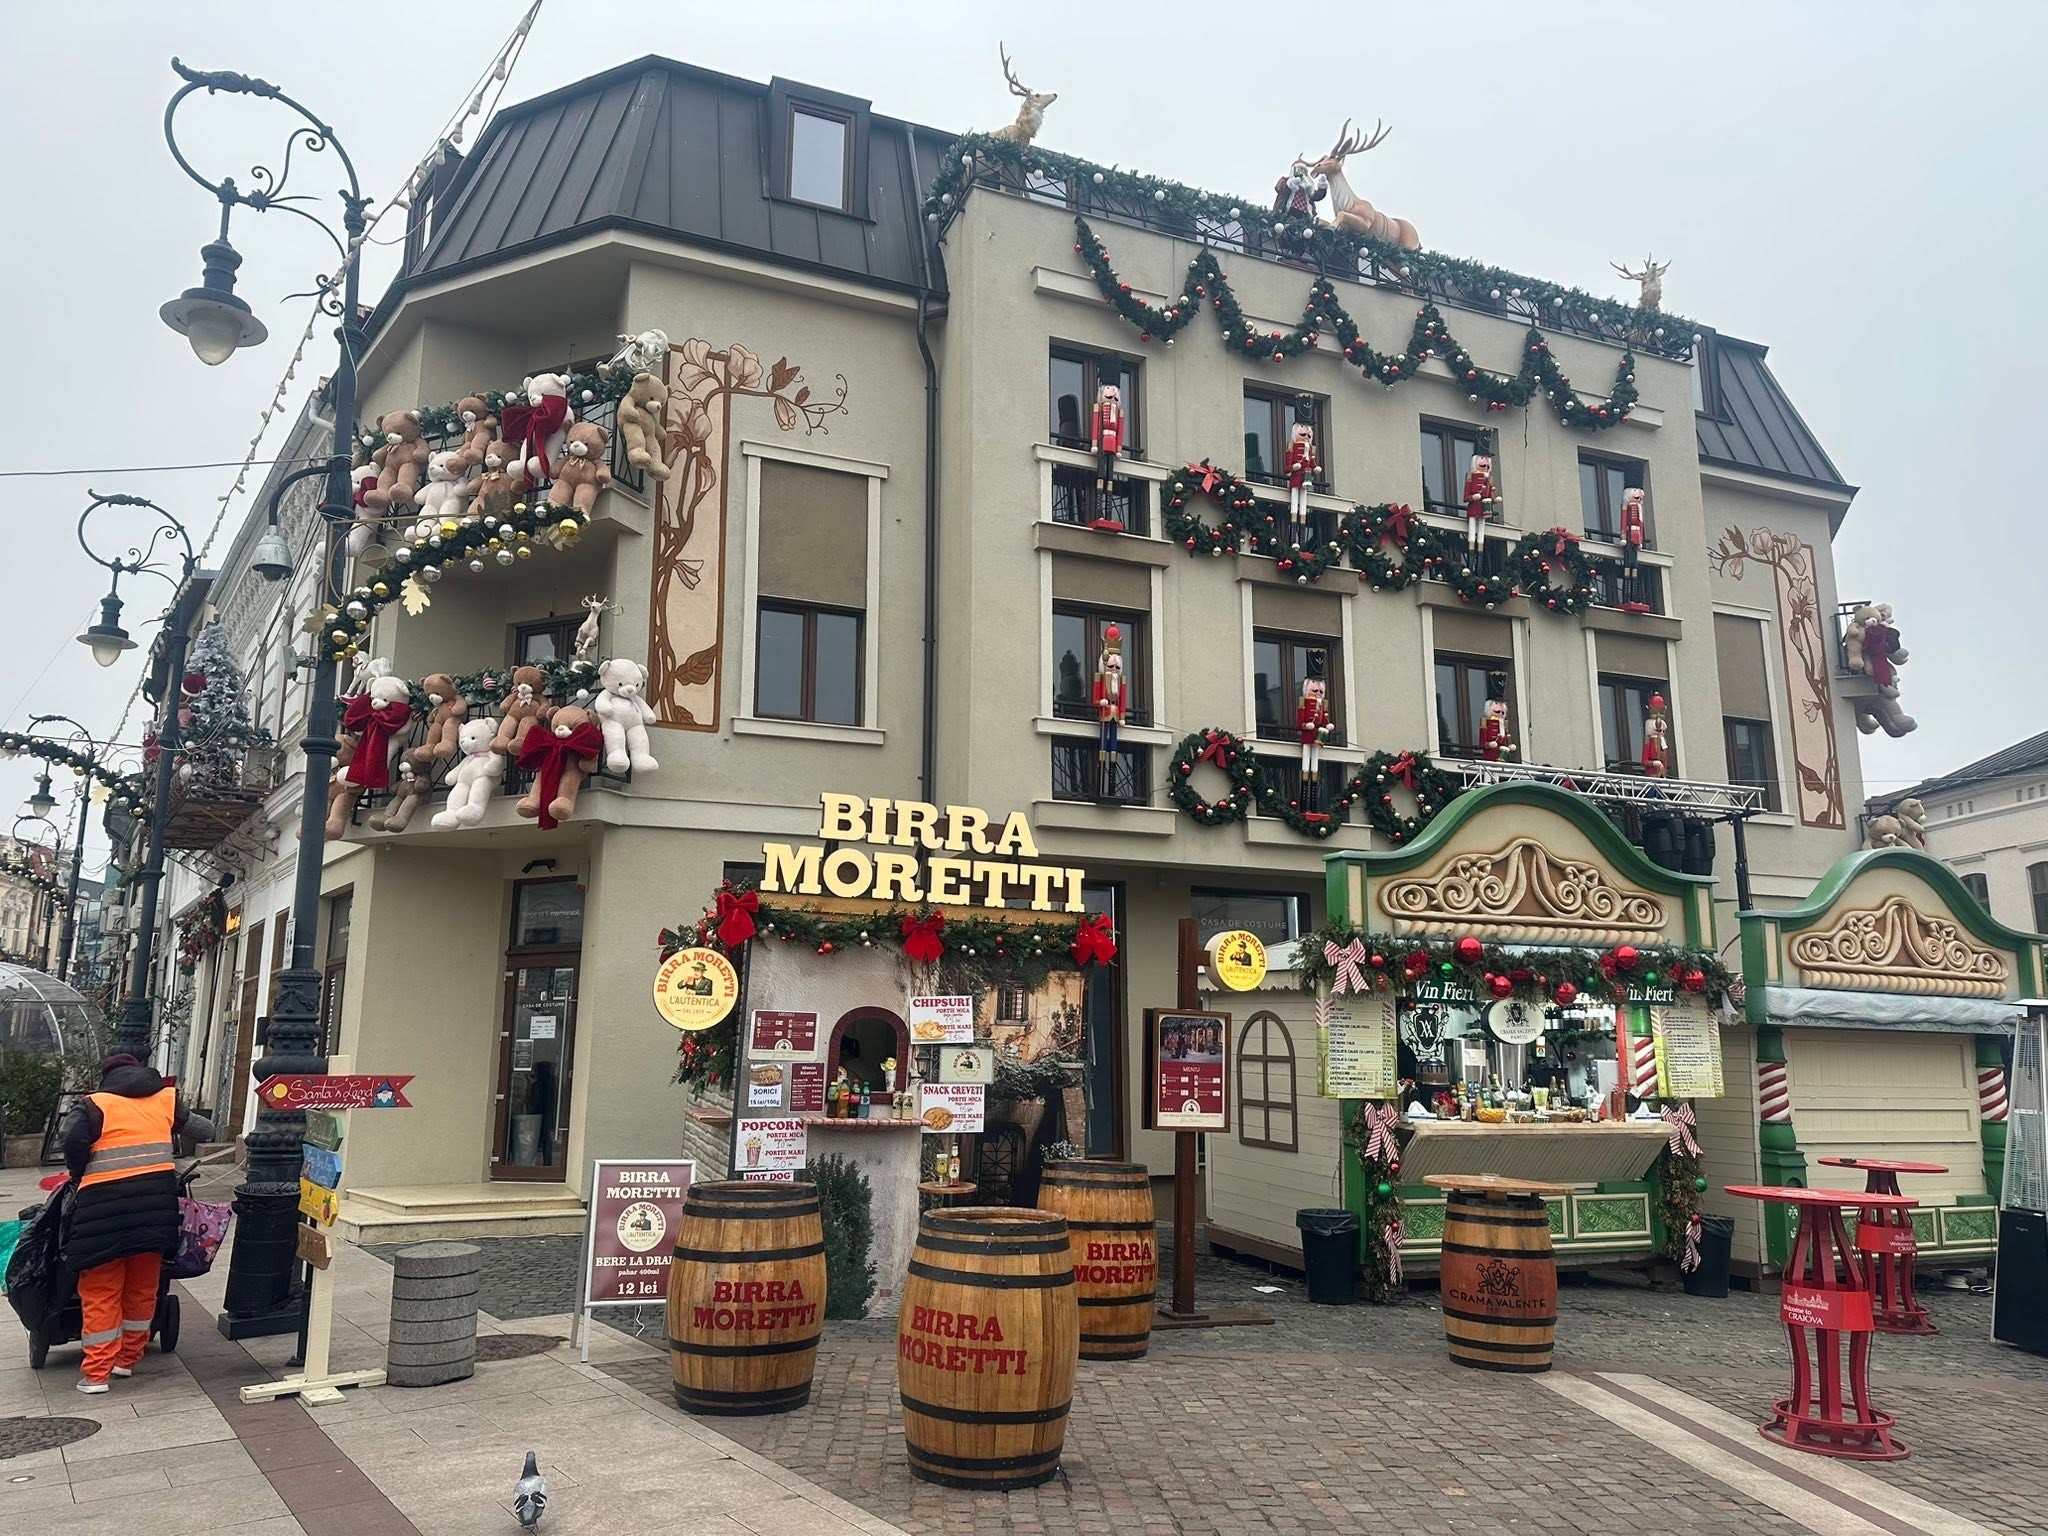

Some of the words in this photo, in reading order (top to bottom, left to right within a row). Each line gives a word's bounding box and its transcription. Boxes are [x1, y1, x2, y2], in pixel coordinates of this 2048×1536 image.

[819, 792, 1039, 857] BIRRA
[760, 842, 1085, 912] MORETTI
[1244, 921, 1288, 930] COSTUME
[1218, 935, 1237, 964] BIRRA
[1238, 933, 1266, 968] MORETTI
[657, 954, 691, 993] BIRRA
[693, 952, 734, 998] MORETTI
[1416, 980, 1438, 999] Vin
[1627, 983, 1643, 1000] in
[1644, 985, 1674, 1001] Fiert
[670, 996, 720, 1007] L'AUTENTICA
[913, 998, 970, 1007] CHIPSURI
[923, 1086, 949, 1094] SNACK
[951, 1086, 983, 1094] CREVETI
[742, 1121, 804, 1131] POPCORN
[619, 1172, 670, 1183] BIRRA
[606, 1187, 681, 1199] MORETTI
[619, 1206, 638, 1231] BIRRA
[638, 1204, 664, 1231] MORETTI
[1087, 1242, 1152, 1260] BIRRA
[595, 1257, 626, 1267] BERE
[629, 1257, 643, 1266] LA
[1072, 1264, 1156, 1284] MORETT
[618, 1283, 635, 1294] 12
[639, 1282, 658, 1294] lei
[712, 1280, 804, 1303] BIRRA
[1450, 1289, 1493, 1306] CRAMA
[1494, 1299, 1547, 1309] VALENTE
[693, 1304, 816, 1330] MORETTI
[911, 1305, 1004, 1342] BIRRA
[1788, 1312, 1824, 1325] CRAIOVA
[899, 1333, 1028, 1375] MORETTI
